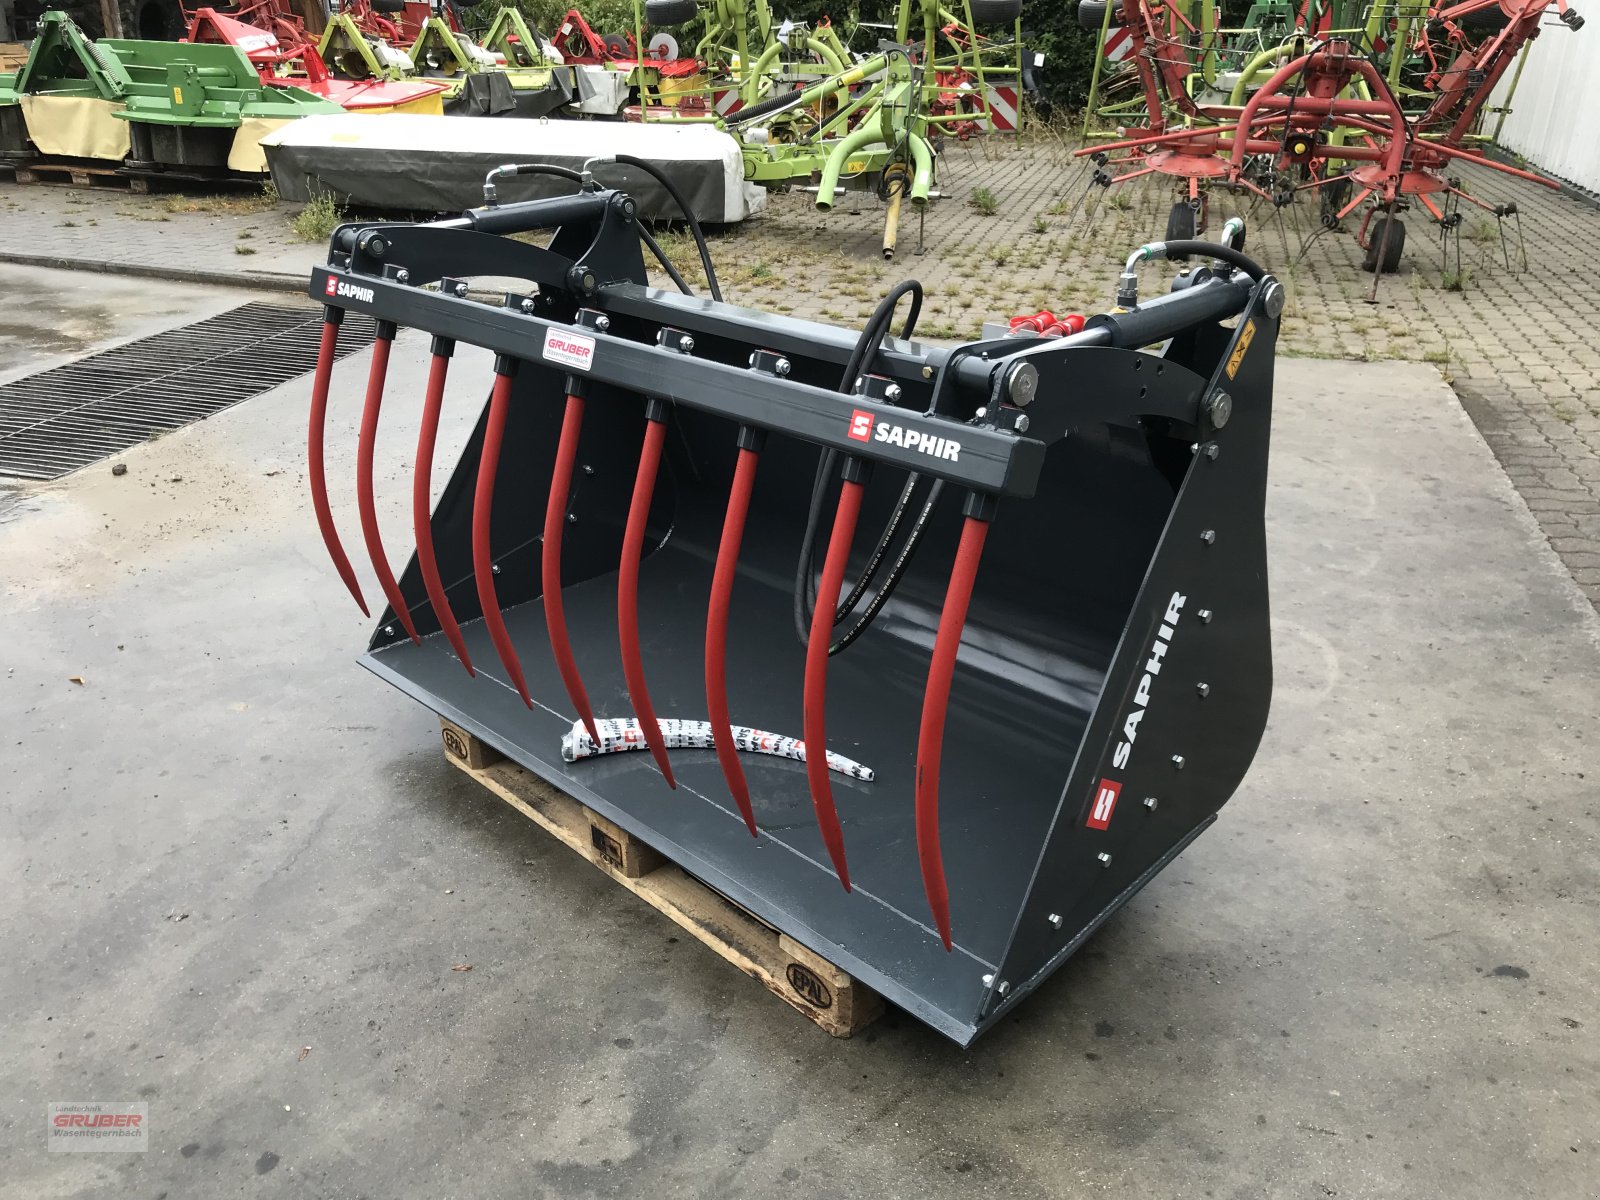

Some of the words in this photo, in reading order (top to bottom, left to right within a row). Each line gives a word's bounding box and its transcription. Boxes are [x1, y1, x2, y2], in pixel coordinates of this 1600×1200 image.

[337, 282, 375, 304] SAPHIR
[548, 338, 591, 358] GRUBER
[874, 422, 961, 462] SAPHIR
[1112, 591, 1187, 770] SAPHIR
